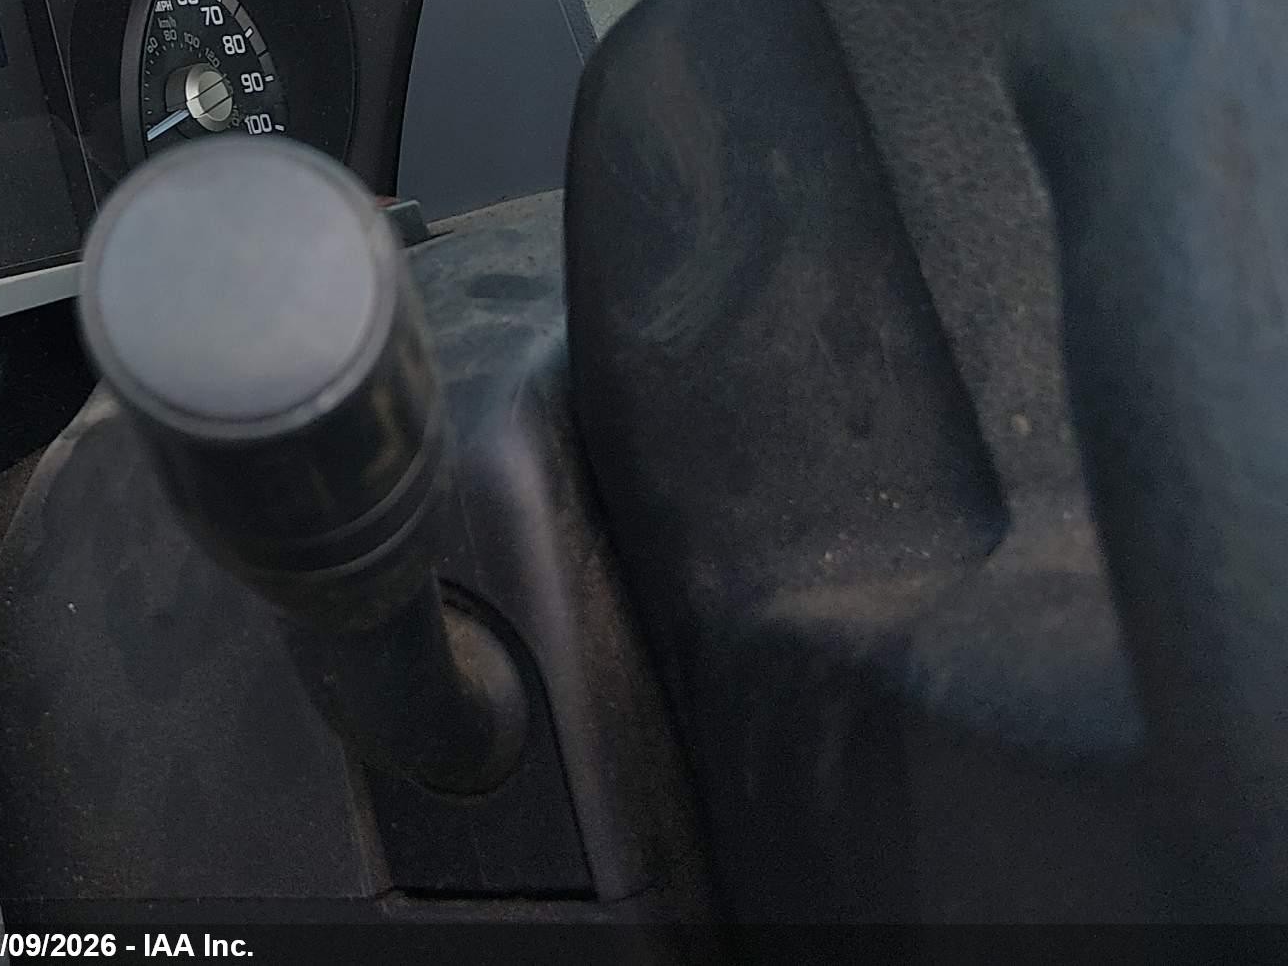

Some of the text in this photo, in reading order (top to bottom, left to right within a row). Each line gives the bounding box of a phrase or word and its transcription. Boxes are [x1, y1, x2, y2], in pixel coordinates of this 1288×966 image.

[155, 0, 174, 12] MPH
[200, 5, 224, 26] 70
[222, 34, 246, 55] 80
[240, 72, 264, 93] 90
[244, 113, 273, 135] 100
